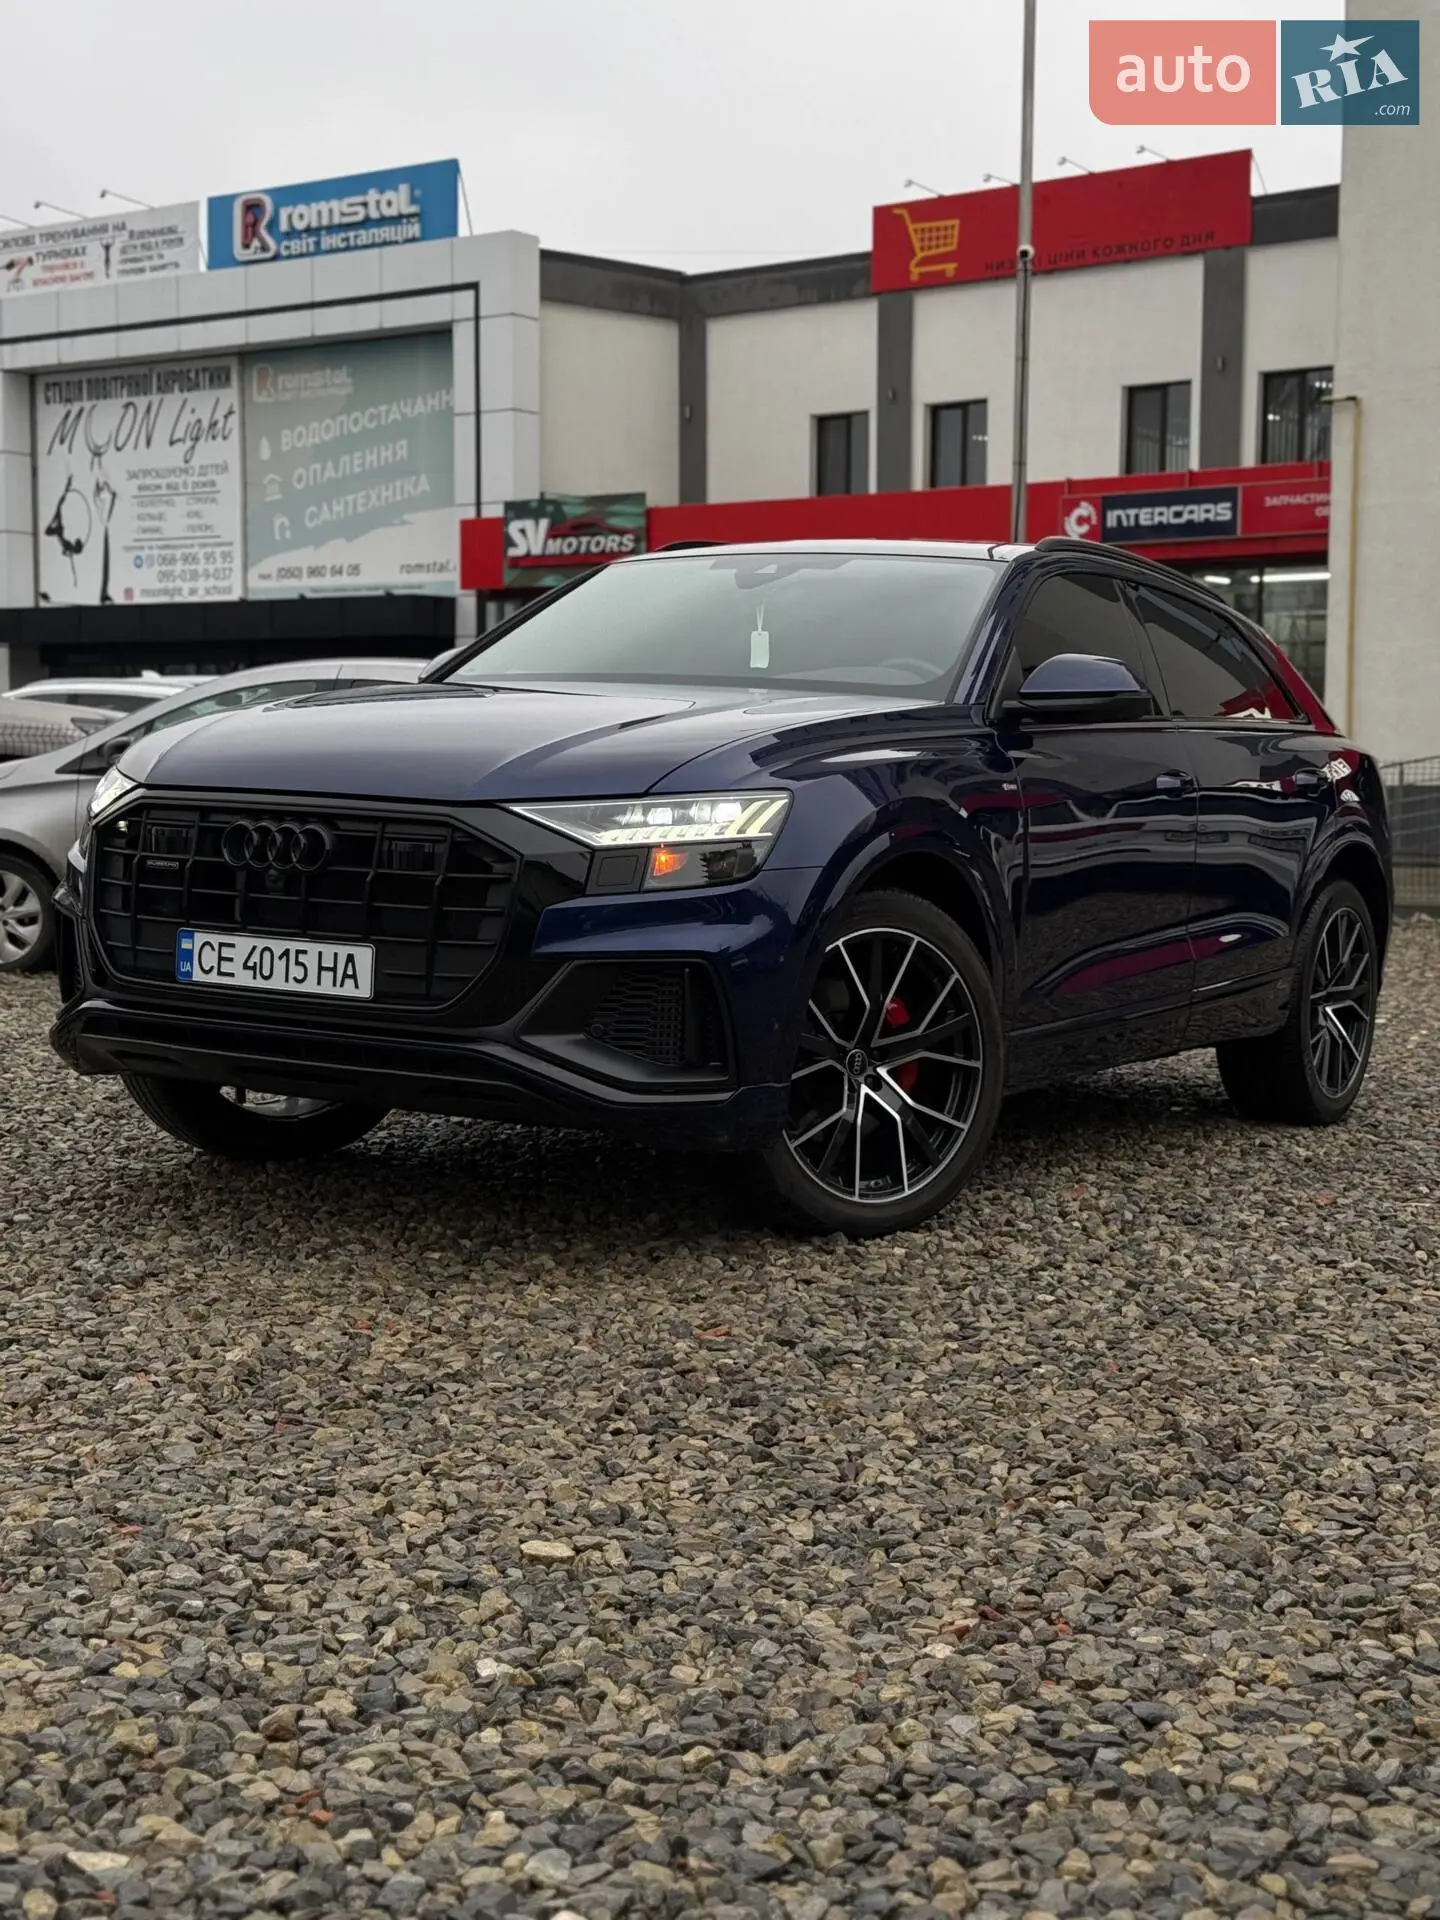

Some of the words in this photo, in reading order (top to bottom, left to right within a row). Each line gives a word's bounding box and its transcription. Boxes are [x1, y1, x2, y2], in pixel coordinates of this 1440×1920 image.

[280, 234, 316, 257] світ
[321, 219, 420, 250] інсталяцій
[984, 254, 1042, 273] НИЗКІ
[1092, 236, 1174, 259] КОЖНОГО
[169, 397, 236, 464] Light
[292, 439, 408, 490] ОПАЛЕННЯ
[304, 474, 431, 528] САНТЕХНІКА
[1107, 502, 1233, 528] INTERCARS
[507, 518, 550, 557] SV
[545, 533, 636, 556] MOTORS
[180, 961, 192, 972] UA
[198, 940, 236, 978] CE
[242, 945, 308, 984] 4015
[317, 950, 359, 989] HA
